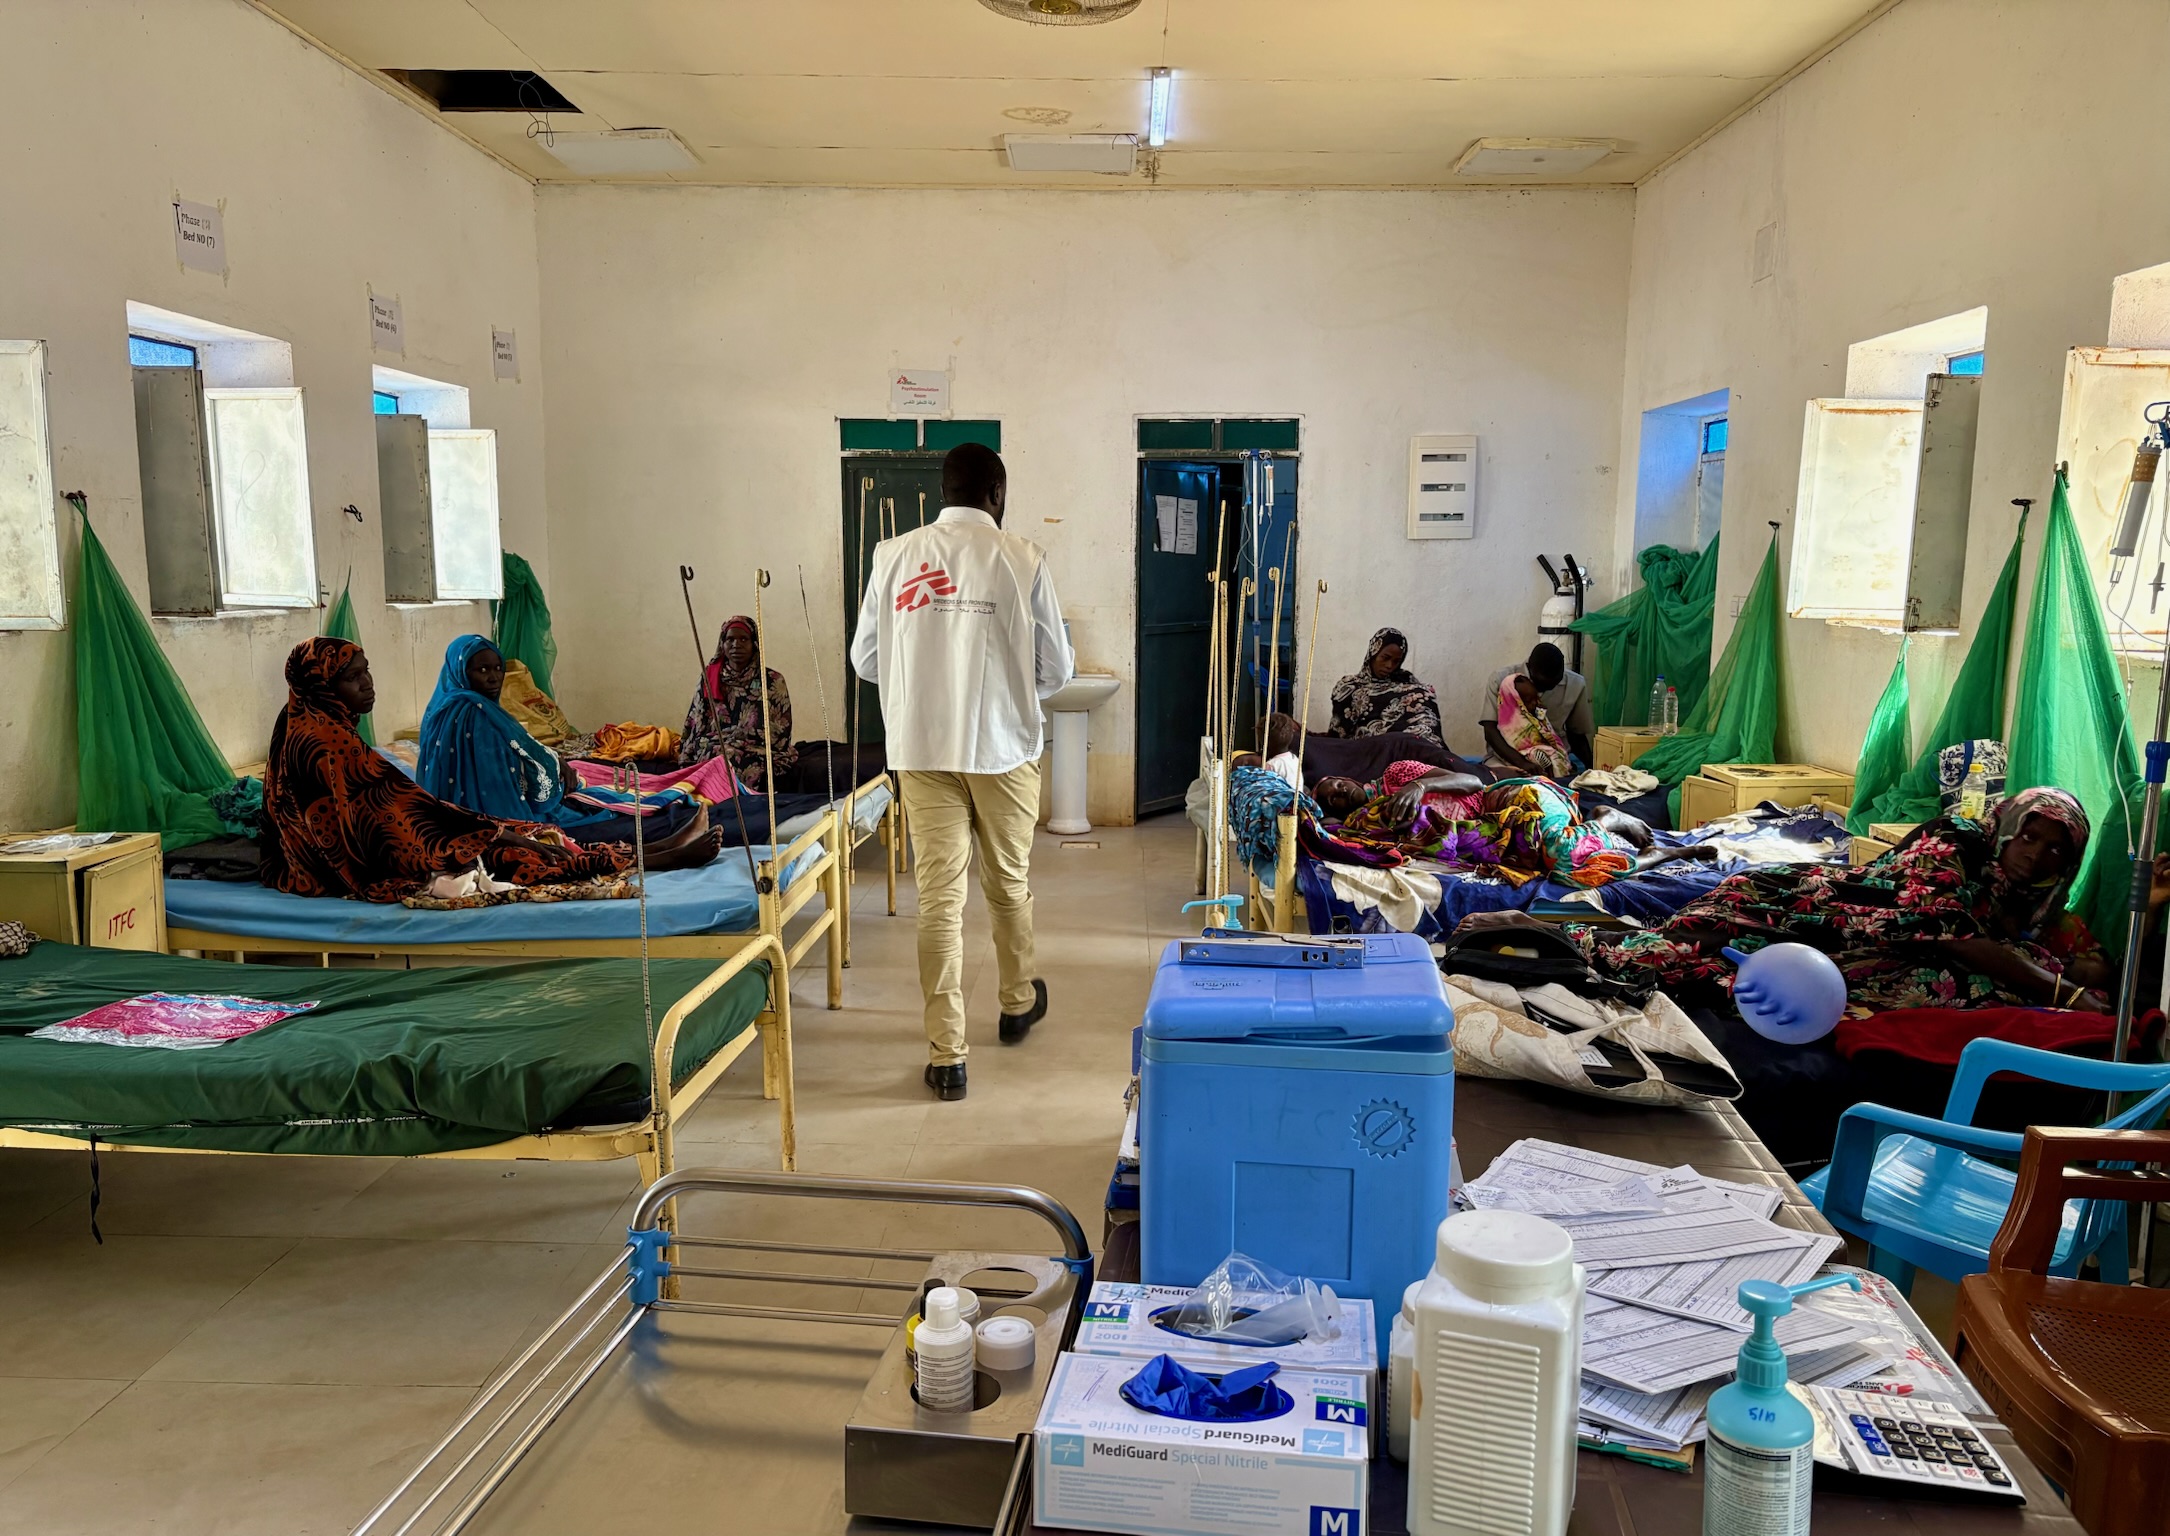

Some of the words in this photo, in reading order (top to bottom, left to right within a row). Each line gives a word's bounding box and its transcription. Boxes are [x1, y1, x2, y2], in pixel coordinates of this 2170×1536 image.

[181, 213, 200, 227] Phase
[184, 230, 195, 242] Bed
[197, 233, 206, 244] NO
[207, 236, 215, 249] (7)
[376, 318, 384, 329] Bed
[109, 907, 136, 940] ITFC
[1095, 1303, 1122, 1317] M
[1095, 1332, 1118, 1340] 200
[1328, 1397, 1355, 1405] NITRILE
[1327, 1404, 1355, 1423] M
[1749, 1407, 1776, 1423] 5/10
[1089, 1420, 1139, 1434] Nitrile
[1144, 1424, 1201, 1439] Special
[1204, 1429, 1296, 1447] MediGuard
[1093, 1442, 1168, 1461] MediGuard
[1172, 1450, 1220, 1466] Special
[1225, 1454, 1269, 1469] Nitrile
[1321, 1511, 1349, 1536] M
